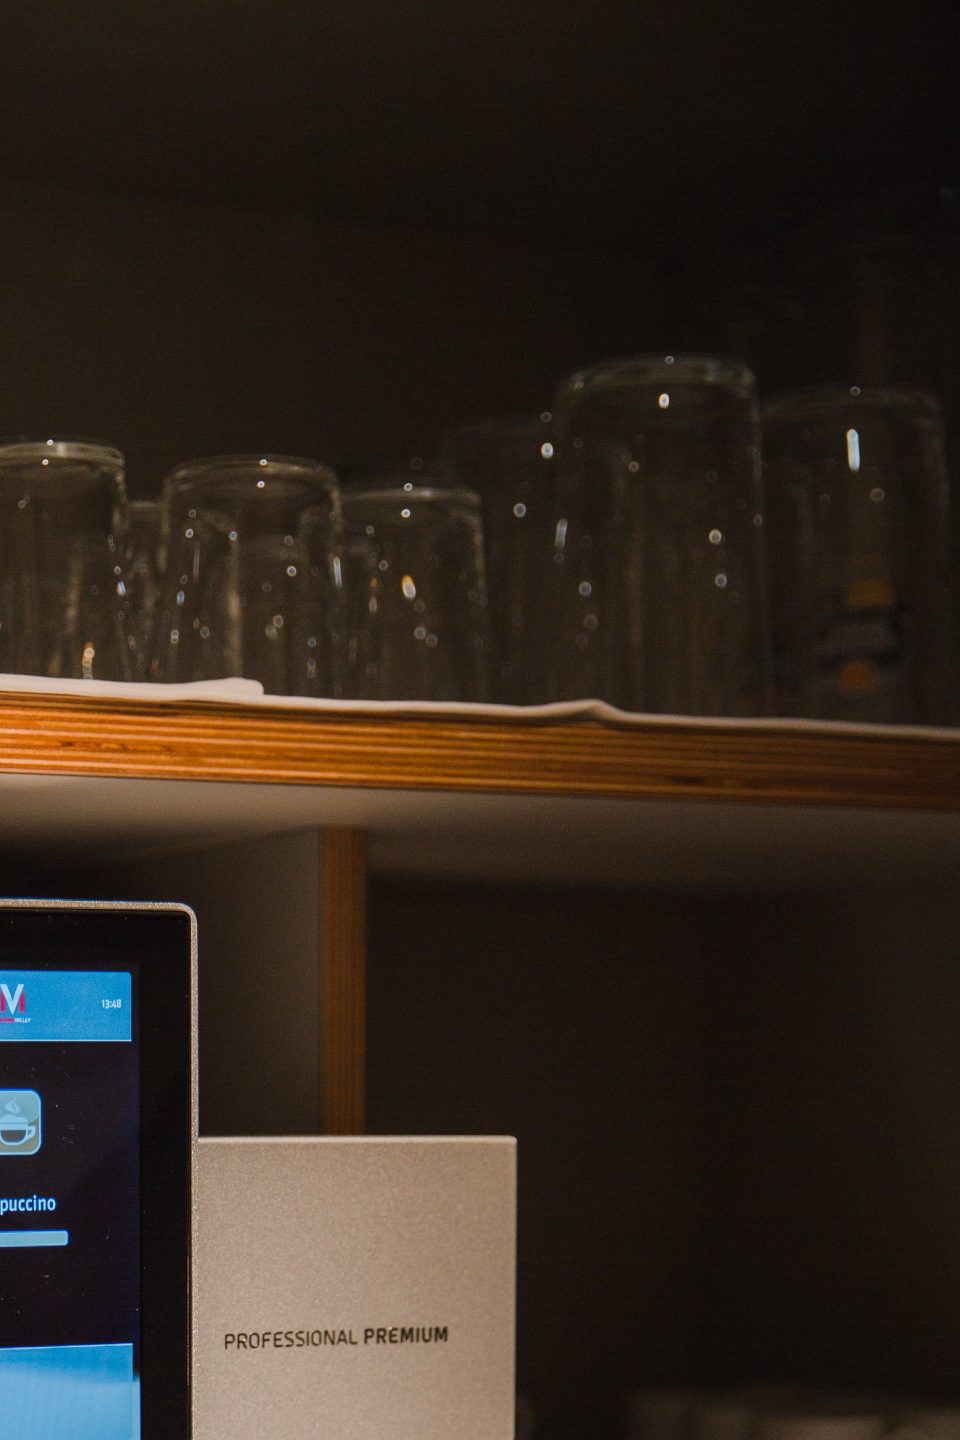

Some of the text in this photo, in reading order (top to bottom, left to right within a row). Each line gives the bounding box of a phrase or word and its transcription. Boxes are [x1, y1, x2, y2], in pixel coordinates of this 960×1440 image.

[101, 998, 122, 1009] 13:48
[224, 1326, 448, 1350] PROFESSIONAL PREMIUM
